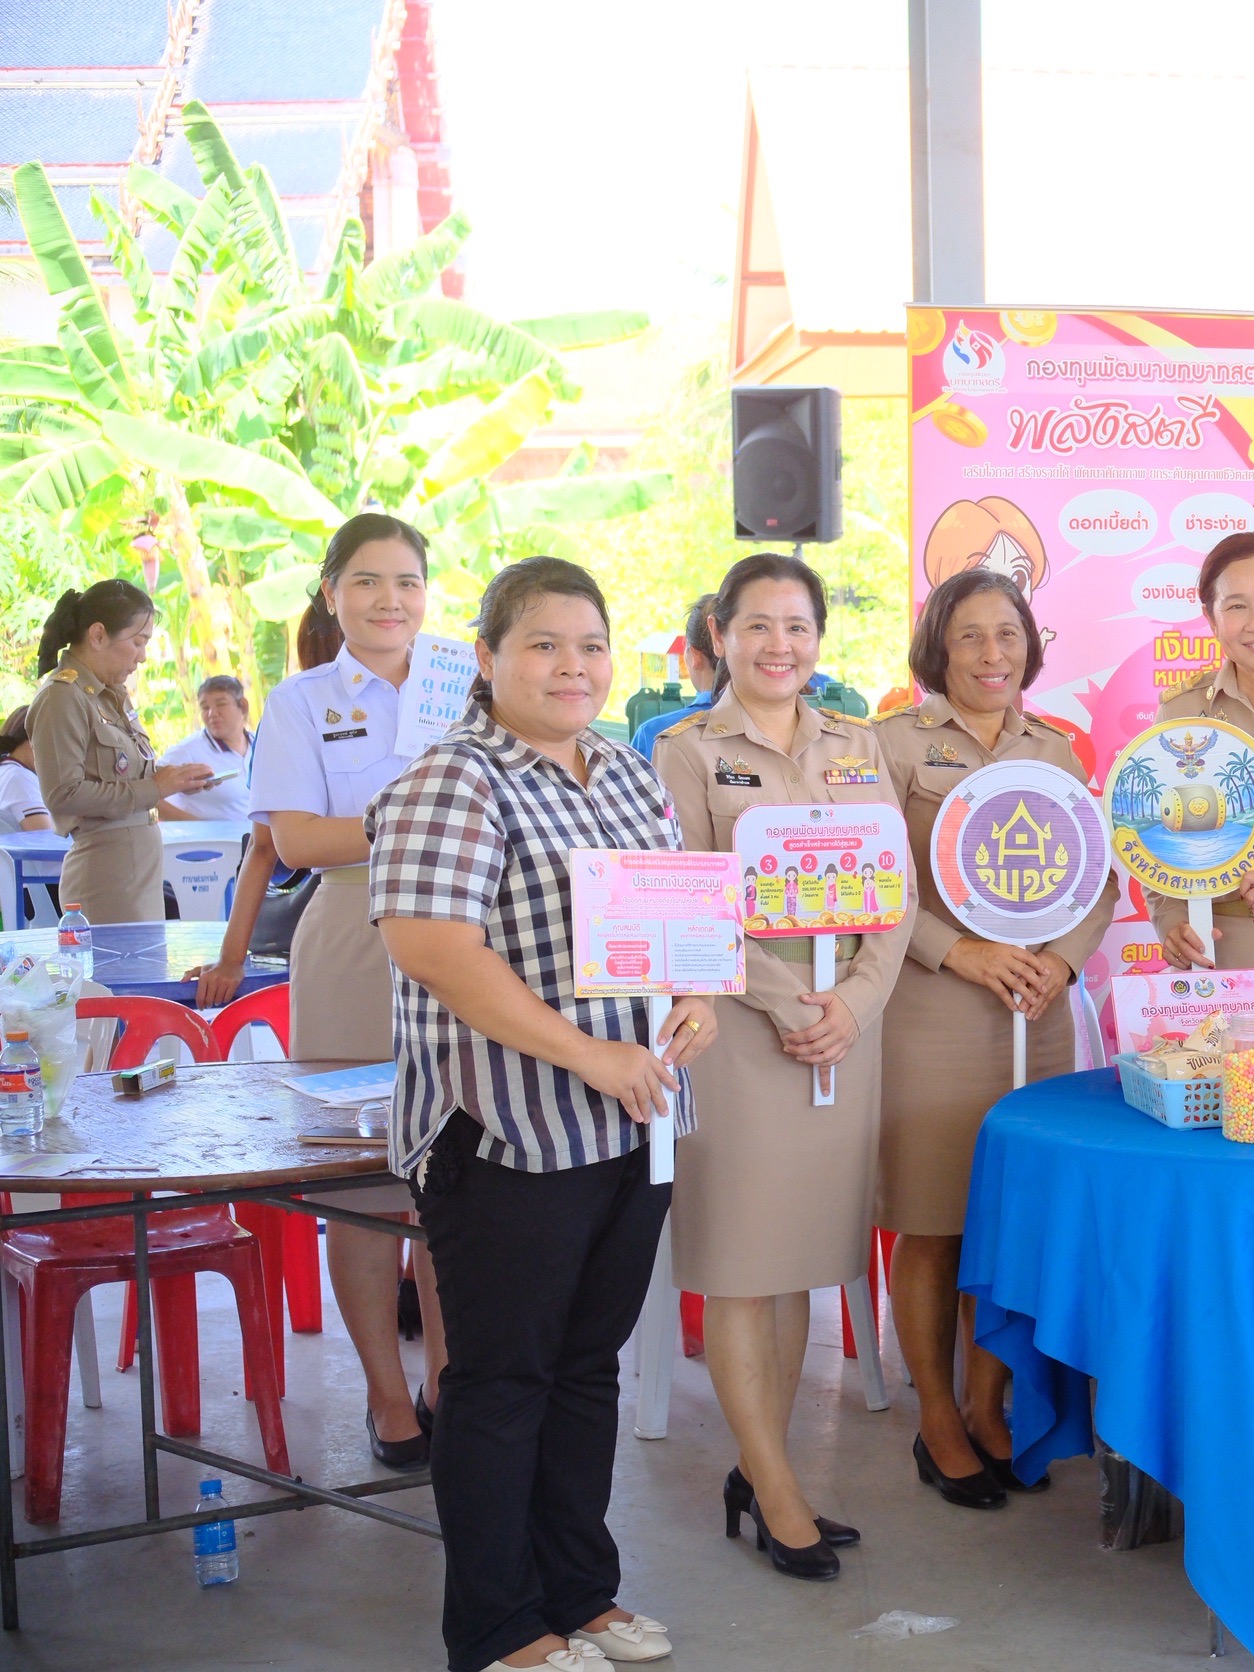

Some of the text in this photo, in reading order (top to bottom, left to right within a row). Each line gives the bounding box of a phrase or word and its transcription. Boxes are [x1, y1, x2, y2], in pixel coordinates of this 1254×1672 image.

[1010, 395, 1219, 452] พลังสตรี
[963, 464, 1014, 478] เสริมโอกาส
[1018, 465, 1070, 478] สร้างรายได้
[1074, 465, 1145, 479] พัฒนาศักยภาพ
[1069, 511, 1247, 531] ดอกเบี้ยต่ำ ชำระง่าย
[1154, 632, 1224, 668] เงินทุ
[766, 823, 881, 839] กองทุนพัฒนาบทบาทสตรี
[765, 854, 893, 871] 3 2 2 10
[632, 873, 721, 894] ประเภทเงินอุดหนุน
